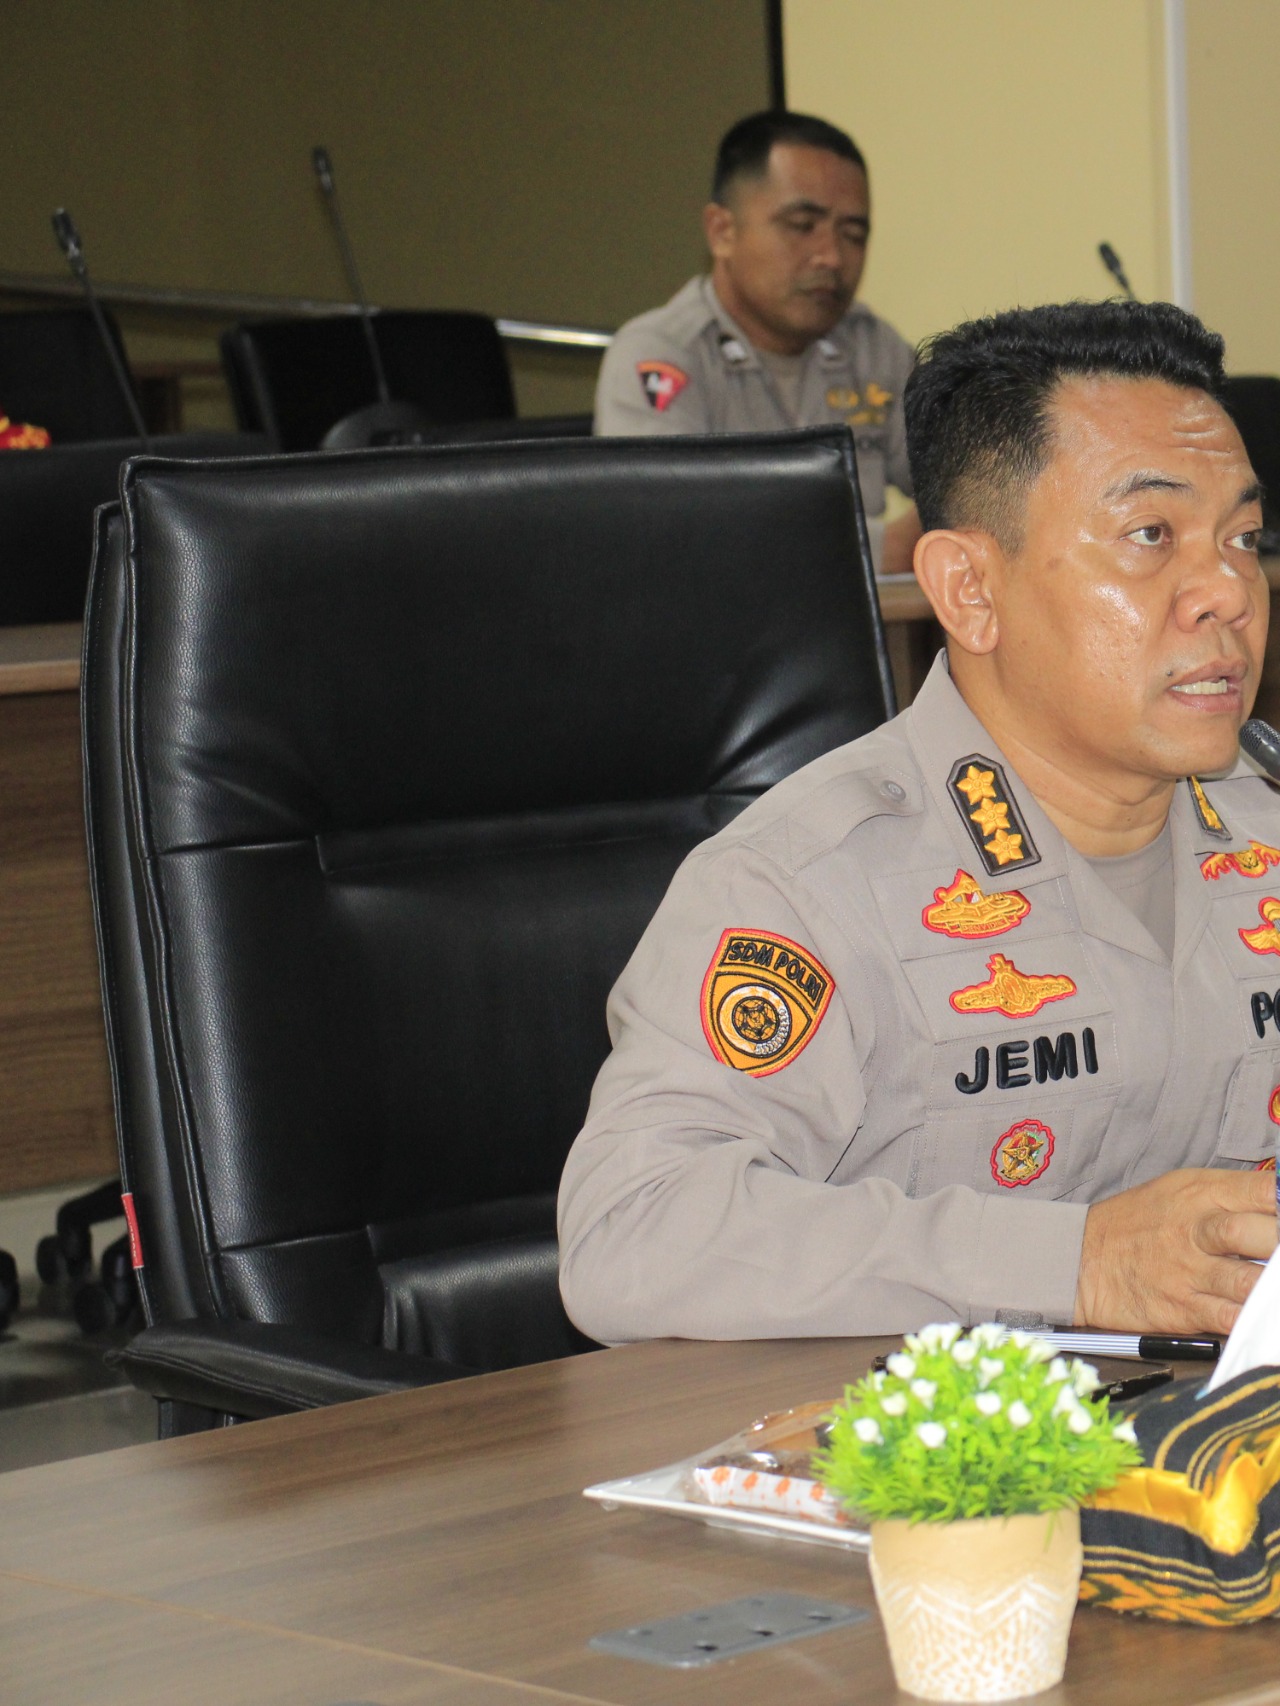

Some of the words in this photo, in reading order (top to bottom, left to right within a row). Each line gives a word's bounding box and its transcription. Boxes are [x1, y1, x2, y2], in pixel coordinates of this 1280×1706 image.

[728, 941, 775, 967] SDM
[773, 951, 822, 1002] POLRI
[954, 1027, 1099, 1095] JEMI
